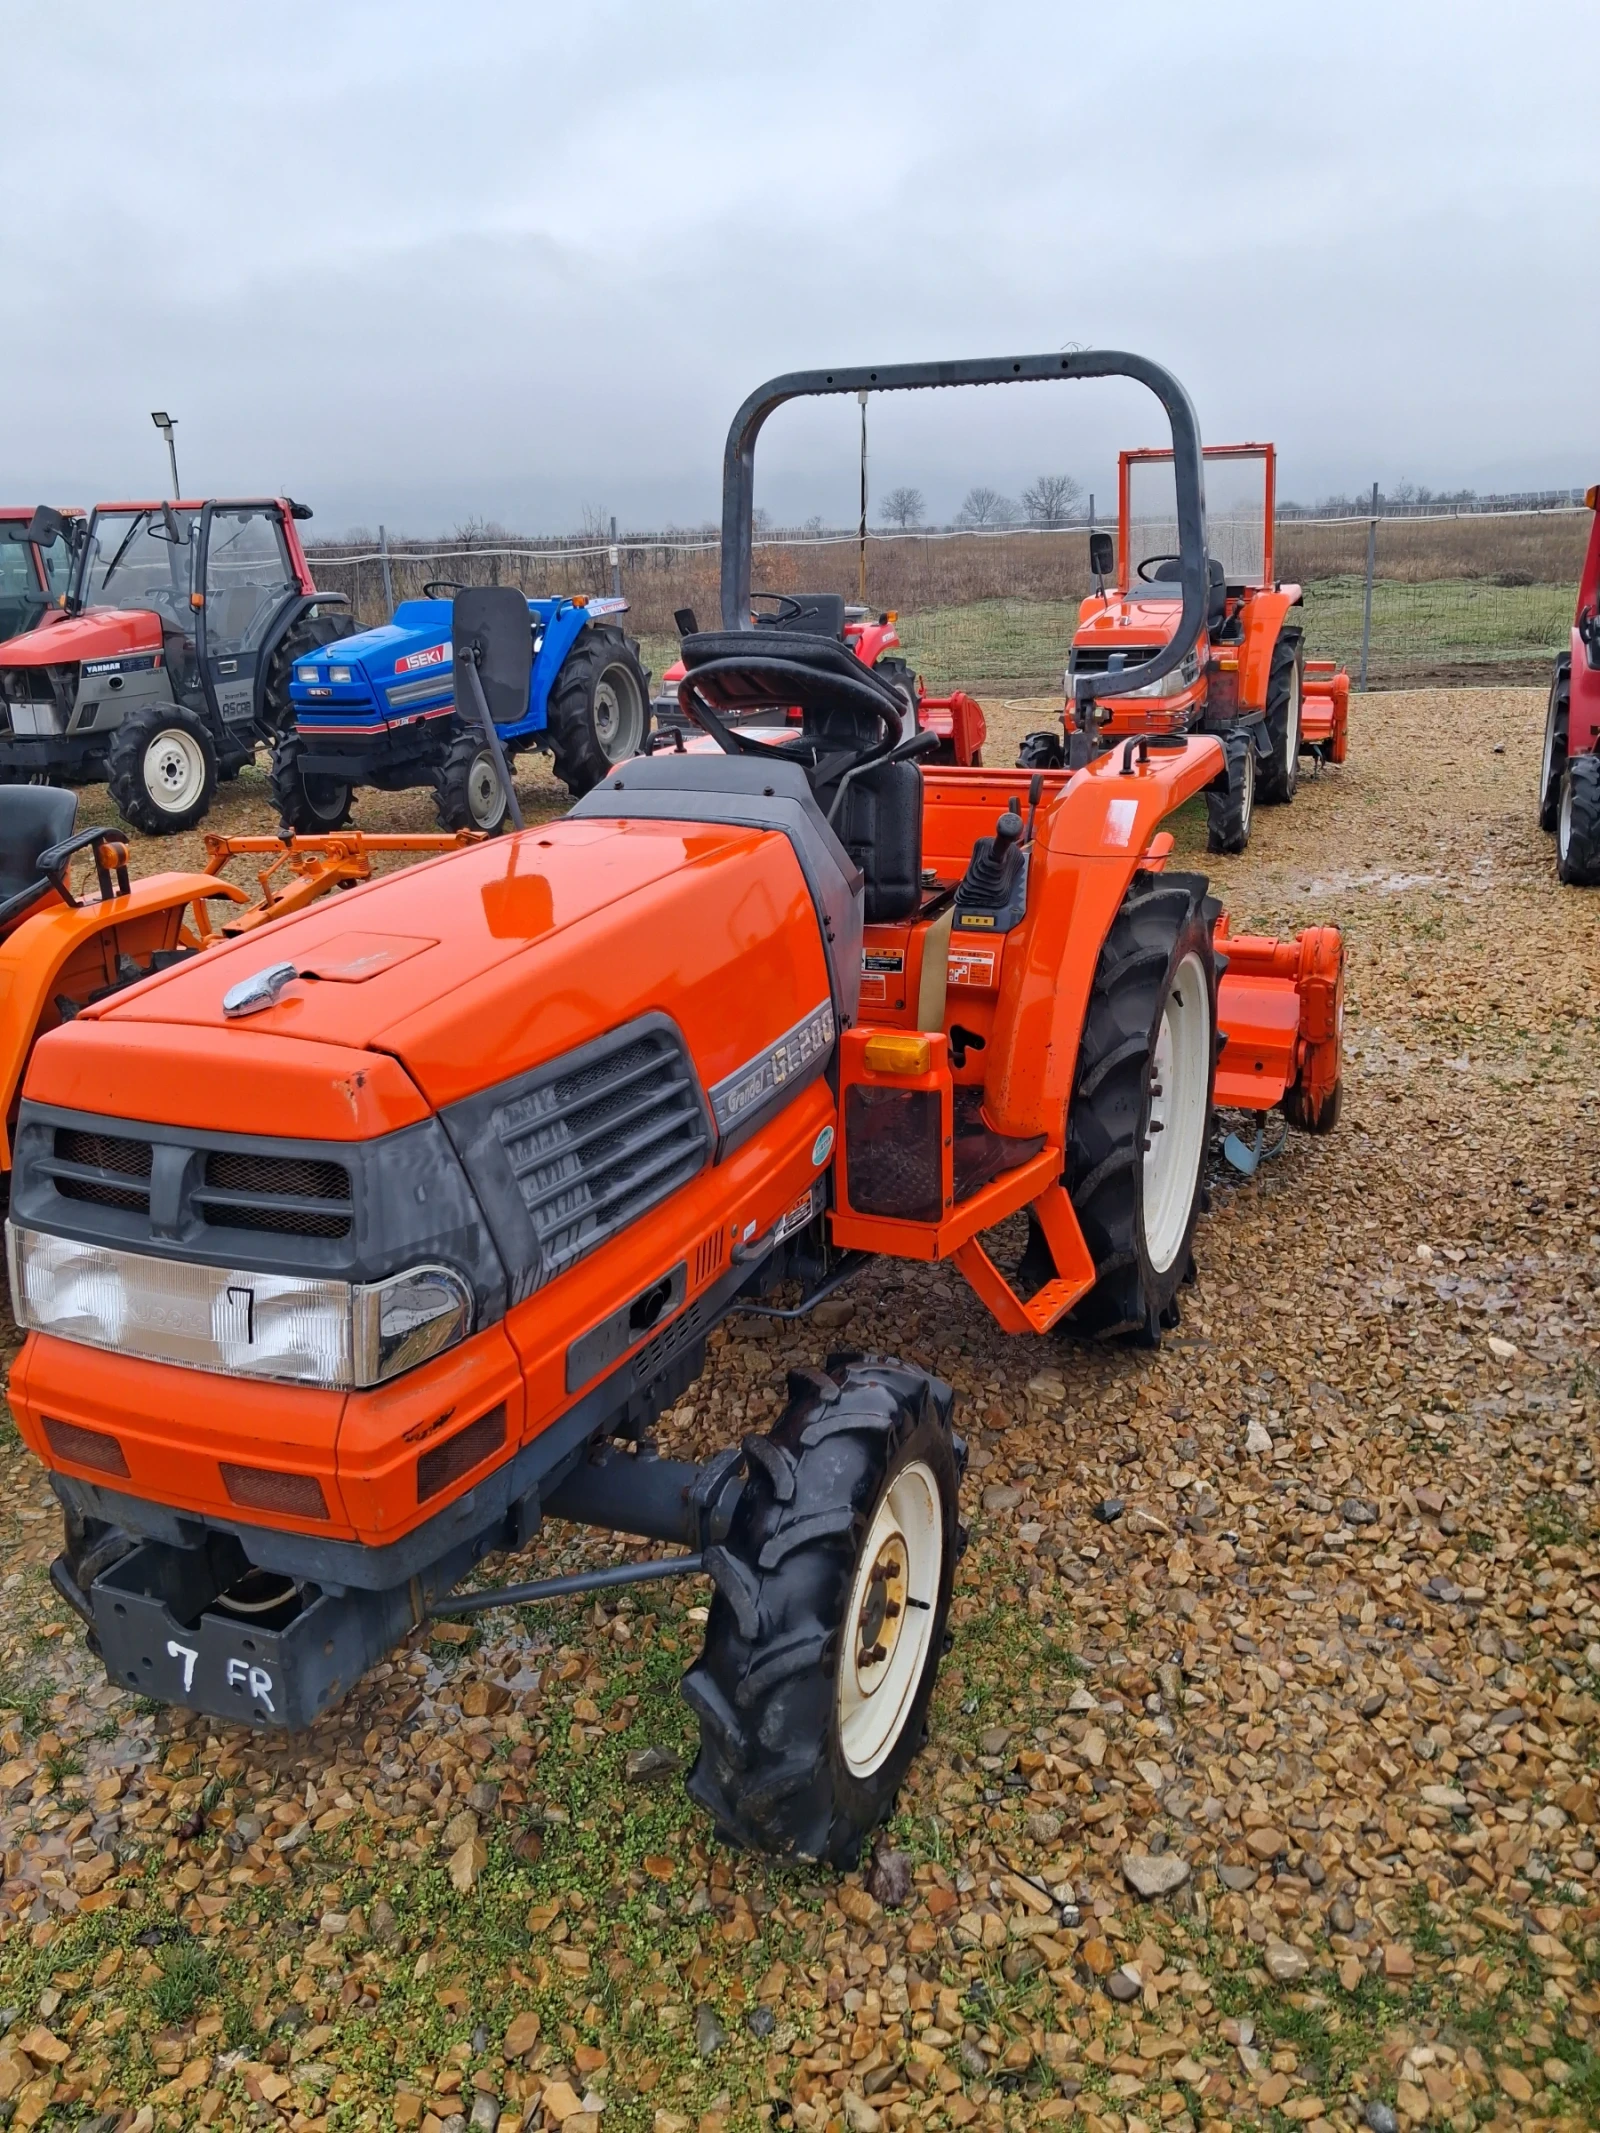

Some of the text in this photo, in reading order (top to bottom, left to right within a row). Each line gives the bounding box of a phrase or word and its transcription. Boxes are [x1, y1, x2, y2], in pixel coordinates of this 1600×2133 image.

[86, 662, 121, 674] YANMAR
[406, 649, 441, 669] ISEKI
[727, 1008, 835, 1112] Grandel GL200
[126, 1298, 209, 1335] Kubota
[226, 1286, 255, 1345] 7
[167, 1640, 275, 1712] 7 FR
